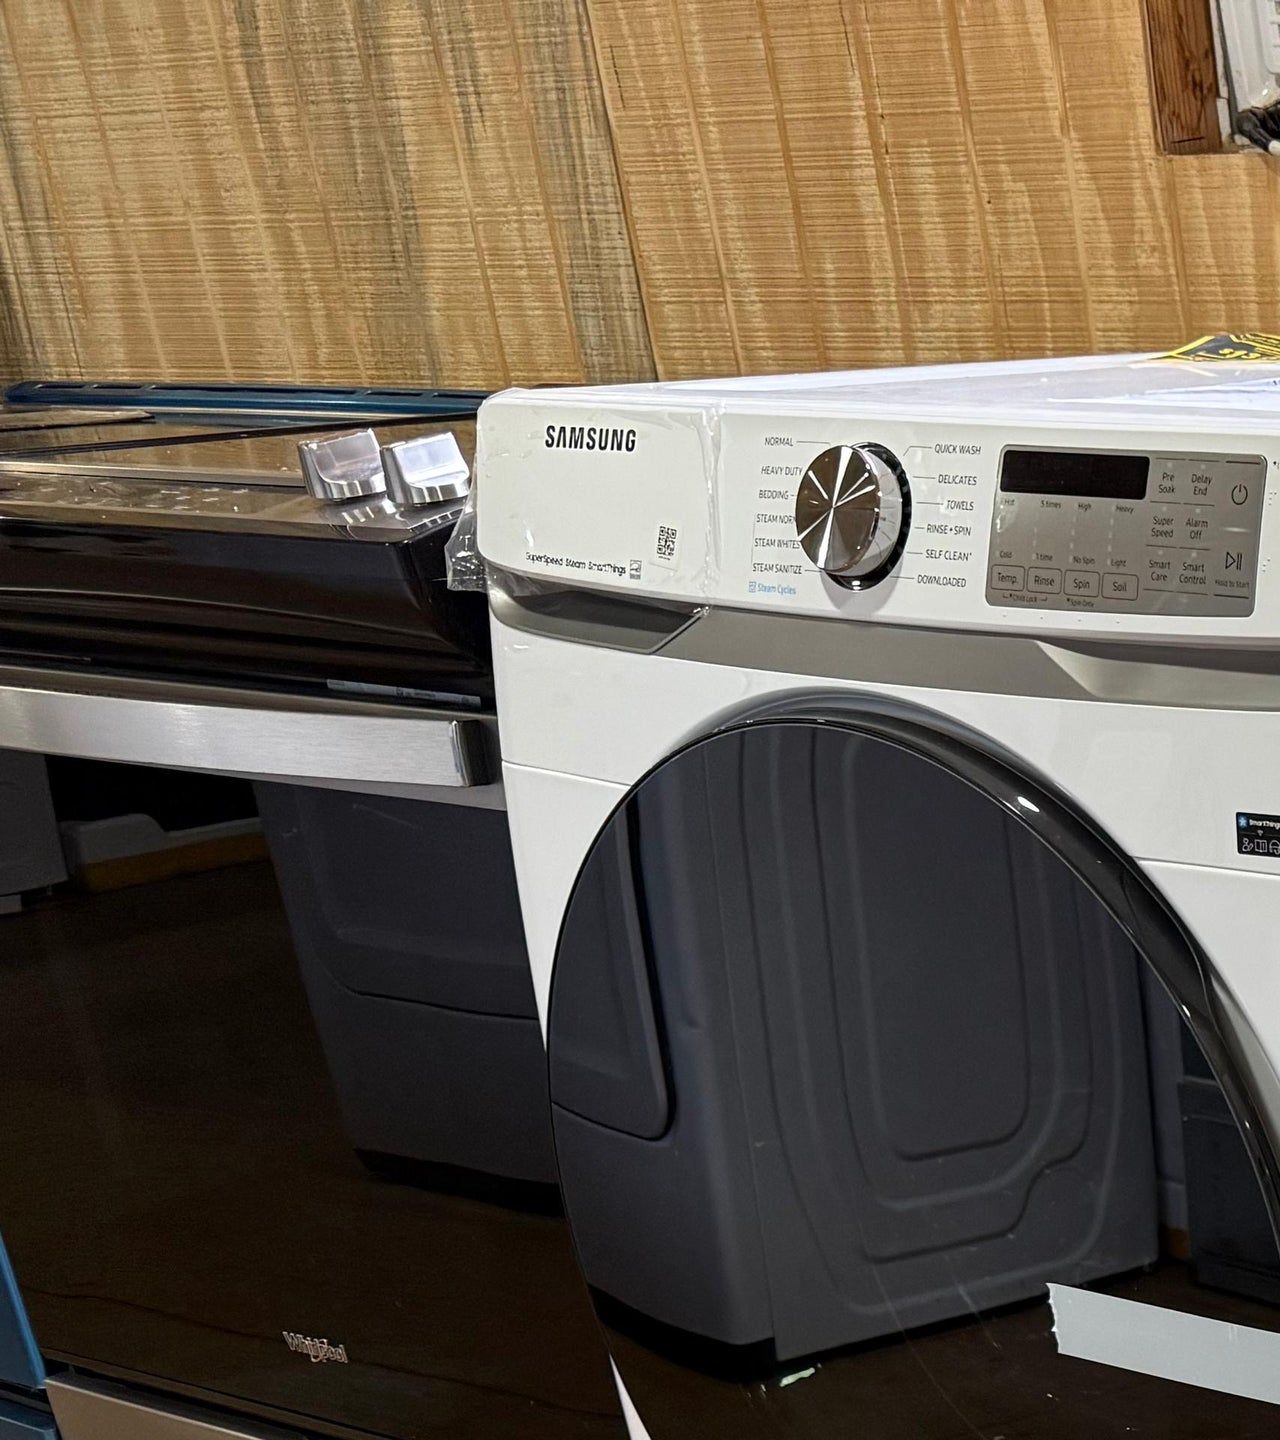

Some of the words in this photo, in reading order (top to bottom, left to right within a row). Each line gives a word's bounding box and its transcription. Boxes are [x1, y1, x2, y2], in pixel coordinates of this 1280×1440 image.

[545, 425, 637, 452] SAMSUNG
[764, 436, 794, 447] NORMAL
[934, 443, 958, 454] QUICK
[959, 445, 982, 456] WASH
[761, 465, 783, 476] HEAVY
[784, 466, 803, 476] DUTY
[938, 474, 977, 486] DELICATES
[1162, 472, 1175, 482] Pre
[1191, 473, 1213, 485] Delay
[758, 489, 789, 500] BEDDING
[1158, 484, 1175, 494] Soak
[1193, 486, 1208, 496] End
[946, 499, 975, 511] TOWELS
[756, 513, 778, 523] STEAM
[779, 514, 796, 525] NOR
[1153, 516, 1174, 527] Super
[1185, 518, 1209, 528] Alarm
[926, 523, 948, 535] RINSE
[954, 525, 972, 537] SPIN
[1151, 527, 1174, 538] Speed
[1189, 530, 1203, 540] Off
[754, 538, 776, 548] STEAM
[925, 548, 943, 560] SELF
[752, 562, 774, 573] STEAM
[774, 563, 802, 575] SANITIZE
[1149, 559, 1171, 570] Smart
[1182, 561, 1205, 573] Smart
[917, 574, 967, 588] DOWNLOADED
[1034, 575, 1055, 587] Rinse
[1151, 571, 1168, 581] Care
[1179, 573, 1207, 585] Control
[1073, 579, 1090, 590] Spin
[1112, 581, 1127, 592] Soil
[282, 1331, 349, 1364] Whirlpool
